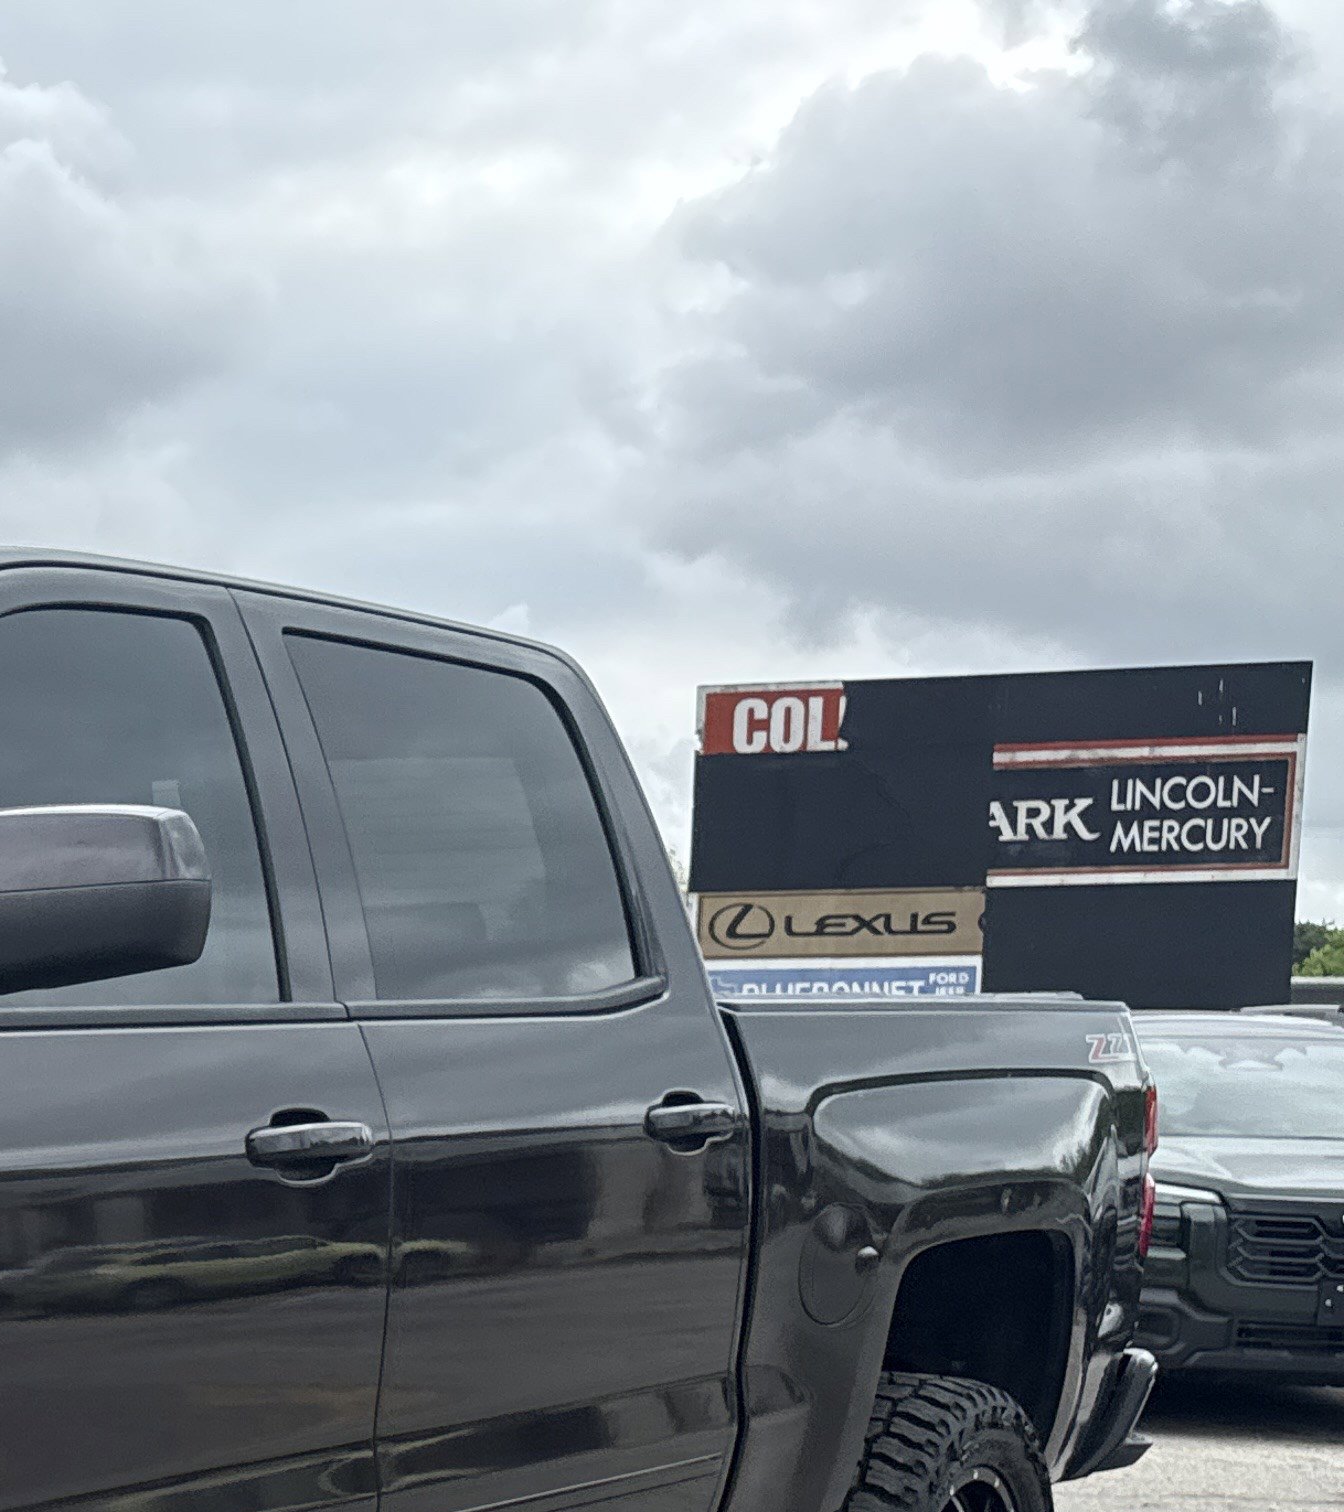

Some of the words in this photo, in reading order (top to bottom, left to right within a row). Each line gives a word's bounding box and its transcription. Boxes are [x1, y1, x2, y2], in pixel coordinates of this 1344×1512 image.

[1110, 773, 1275, 812] LINCOLN-
[1109, 816, 1272, 853] MERCURY
[784, 911, 957, 937] LEXUS
[929, 972, 969, 985] FORD
